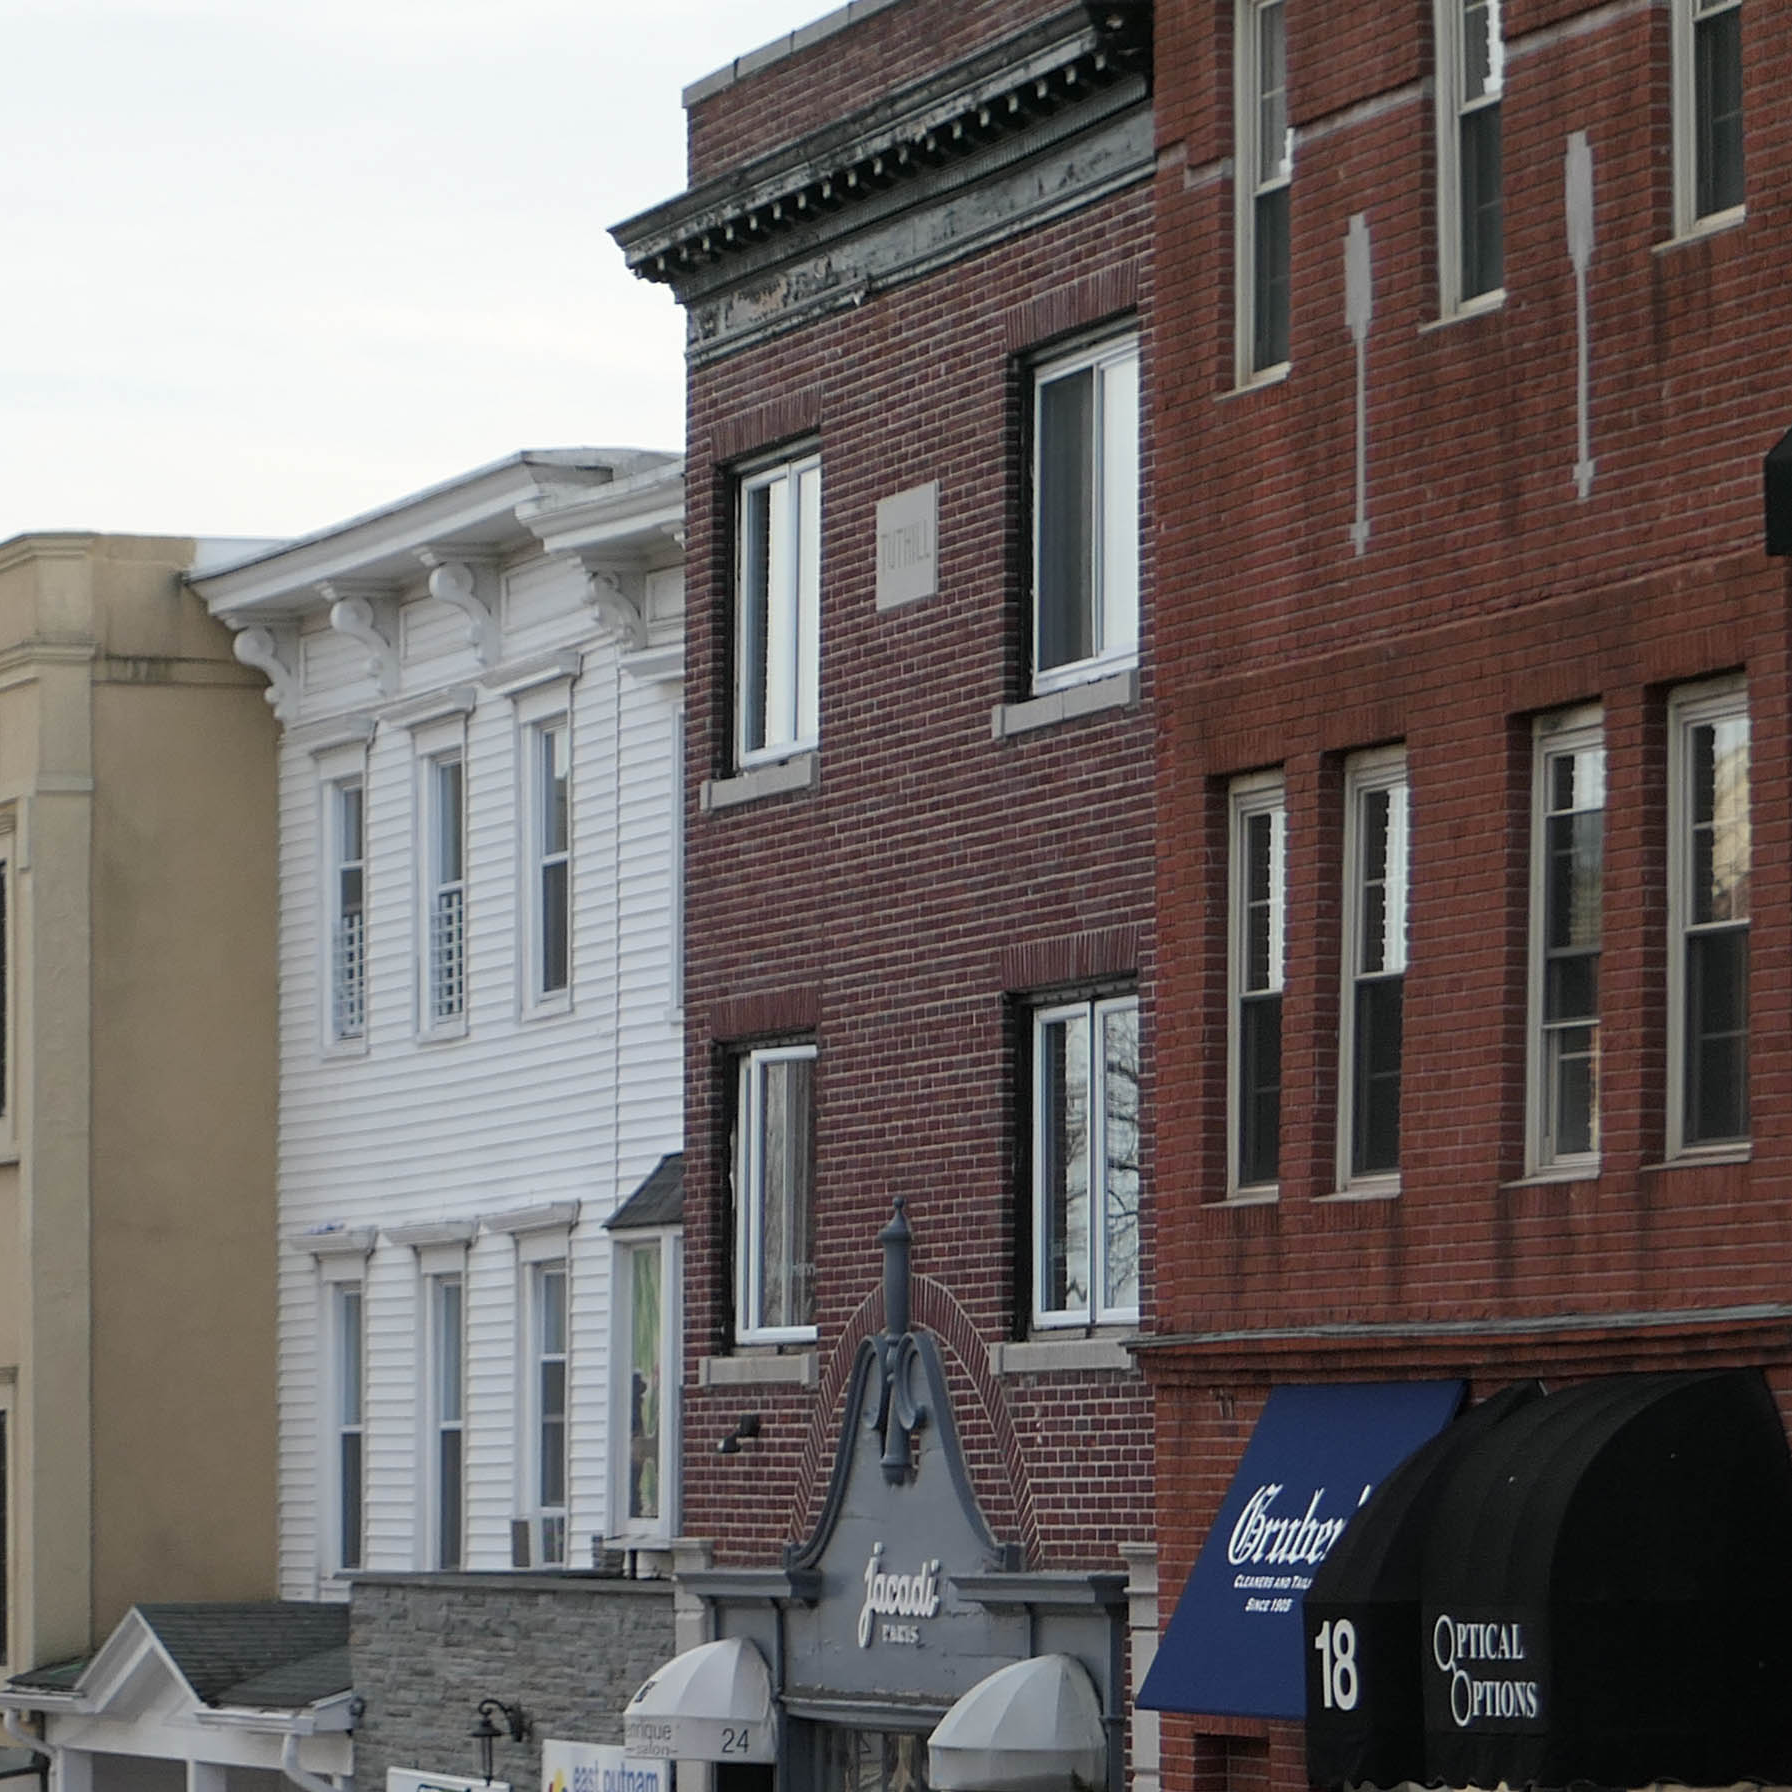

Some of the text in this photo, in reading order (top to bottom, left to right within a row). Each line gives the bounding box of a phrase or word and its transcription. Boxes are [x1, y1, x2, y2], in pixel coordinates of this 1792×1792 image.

[880, 519, 930, 576] TUTHILL
[1233, 1574, 1275, 1590] CLEANERS
[1274, 1576, 1292, 1590] AND
[1245, 1597, 1271, 1613] SINCE
[1315, 1618, 1358, 1711] 18
[1434, 1614, 1524, 1671] OPTICAL
[1451, 1669, 1537, 1727] OPTIONS
[721, 1728, 750, 1753] 24
